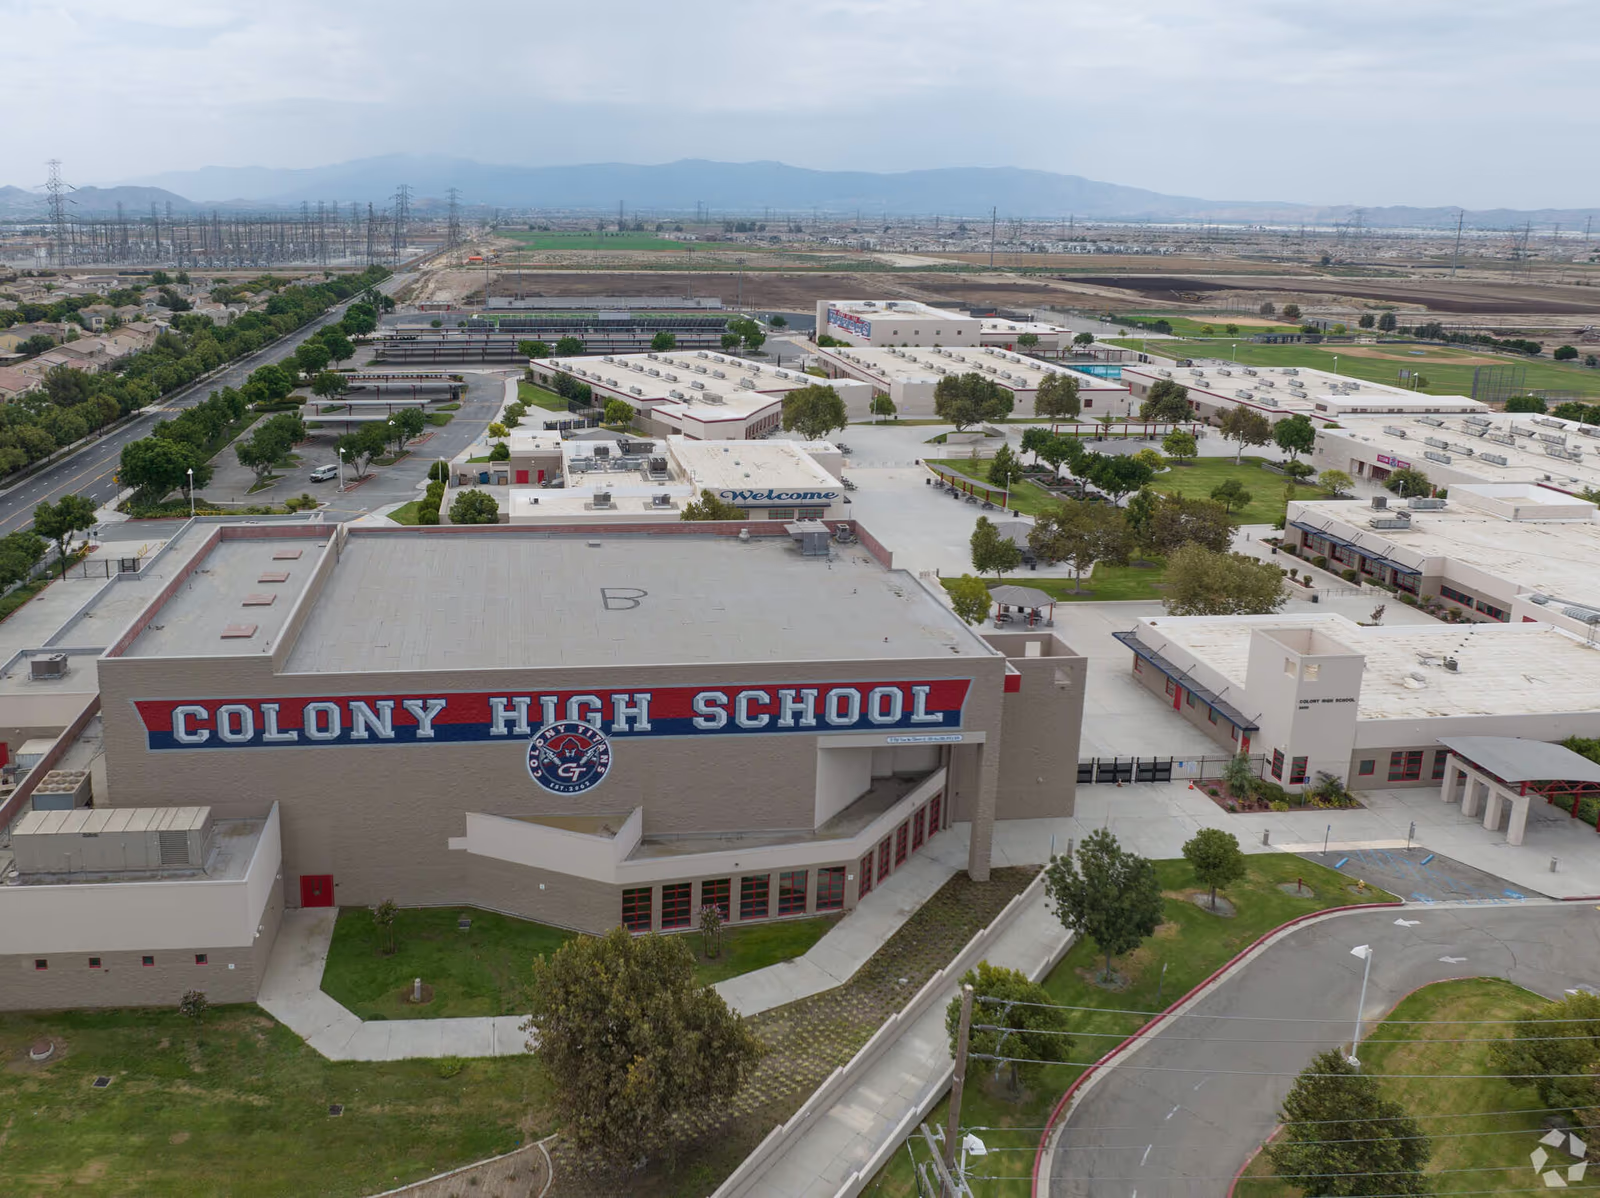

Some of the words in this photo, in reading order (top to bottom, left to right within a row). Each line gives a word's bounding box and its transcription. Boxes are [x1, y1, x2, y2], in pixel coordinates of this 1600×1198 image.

[720, 489, 839, 501] Welcome
[172, 698, 447, 744] COLONY
[489, 692, 652, 737] HIGH
[692, 685, 944, 730] SCHOOL
[530, 725, 566, 777] COLONY
[577, 725, 609, 773] TITANS
